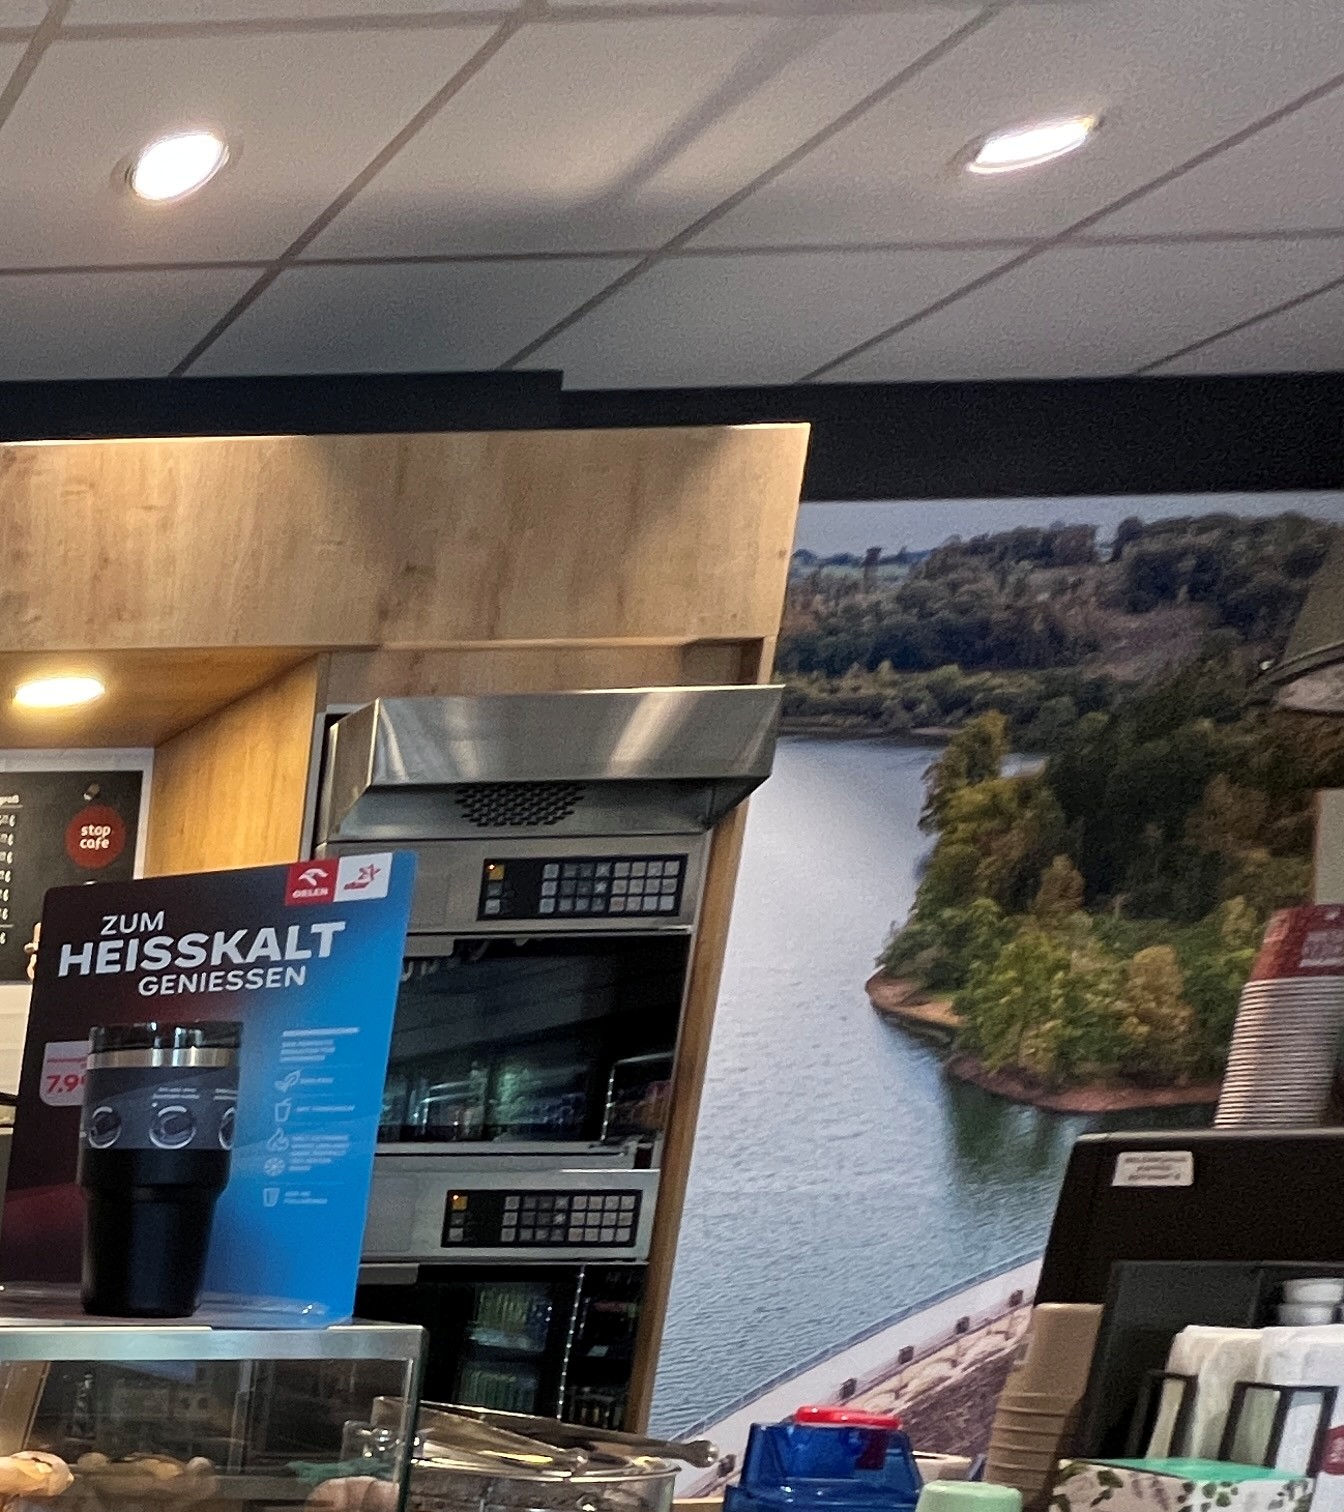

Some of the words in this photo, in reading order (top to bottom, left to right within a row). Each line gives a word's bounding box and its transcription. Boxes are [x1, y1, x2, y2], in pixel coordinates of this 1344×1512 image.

[80, 823, 112, 838] stop
[100, 910, 166, 935] ZUM
[57, 921, 347, 977] HEISSKALT
[138, 965, 307, 997] GENIESSEN
